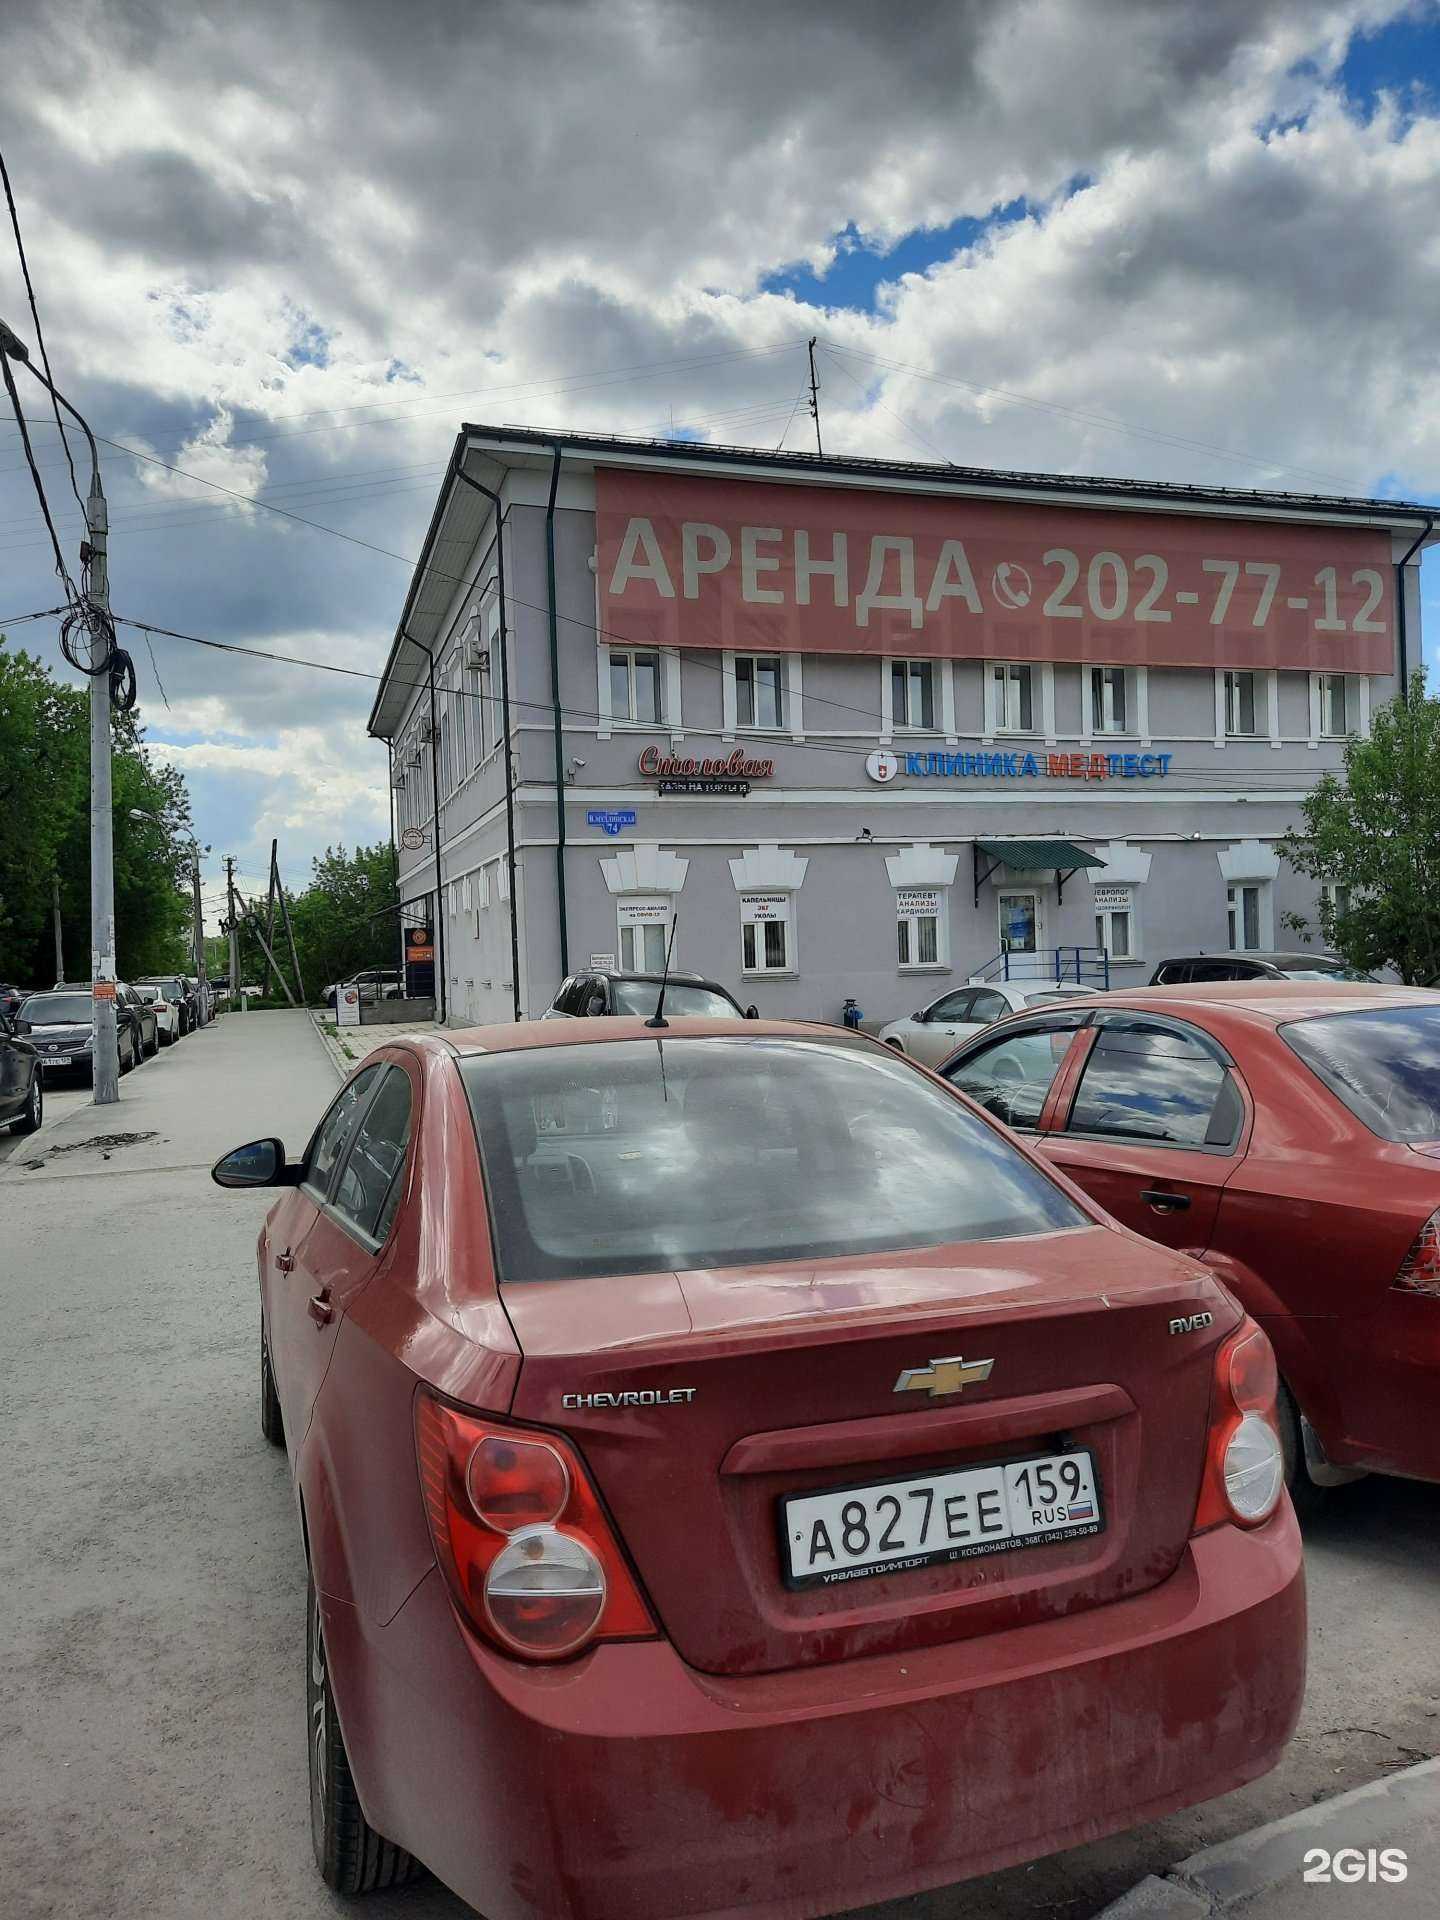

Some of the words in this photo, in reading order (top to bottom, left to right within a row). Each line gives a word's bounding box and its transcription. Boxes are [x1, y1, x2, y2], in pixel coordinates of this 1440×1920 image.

[608, 516, 983, 630] АРЕНДА
[1042, 547, 1387, 634] 202-77-12
[638, 744, 775, 777] Столовая
[904, 750, 1041, 777] КЛИНИКА
[1046, 751, 1173, 781] МЕДТЕСТ
[607, 823, 618, 833] 74
[898, 892, 937, 900] ТЕРАПЕВТ
[1168, 1311, 1214, 1335] AVEO
[561, 1387, 697, 1410] CHEVROLET
[808, 1487, 1004, 1566] А827ЕЕ
[1013, 1457, 1082, 1508] 159
[1031, 1505, 1067, 1526] RUS
